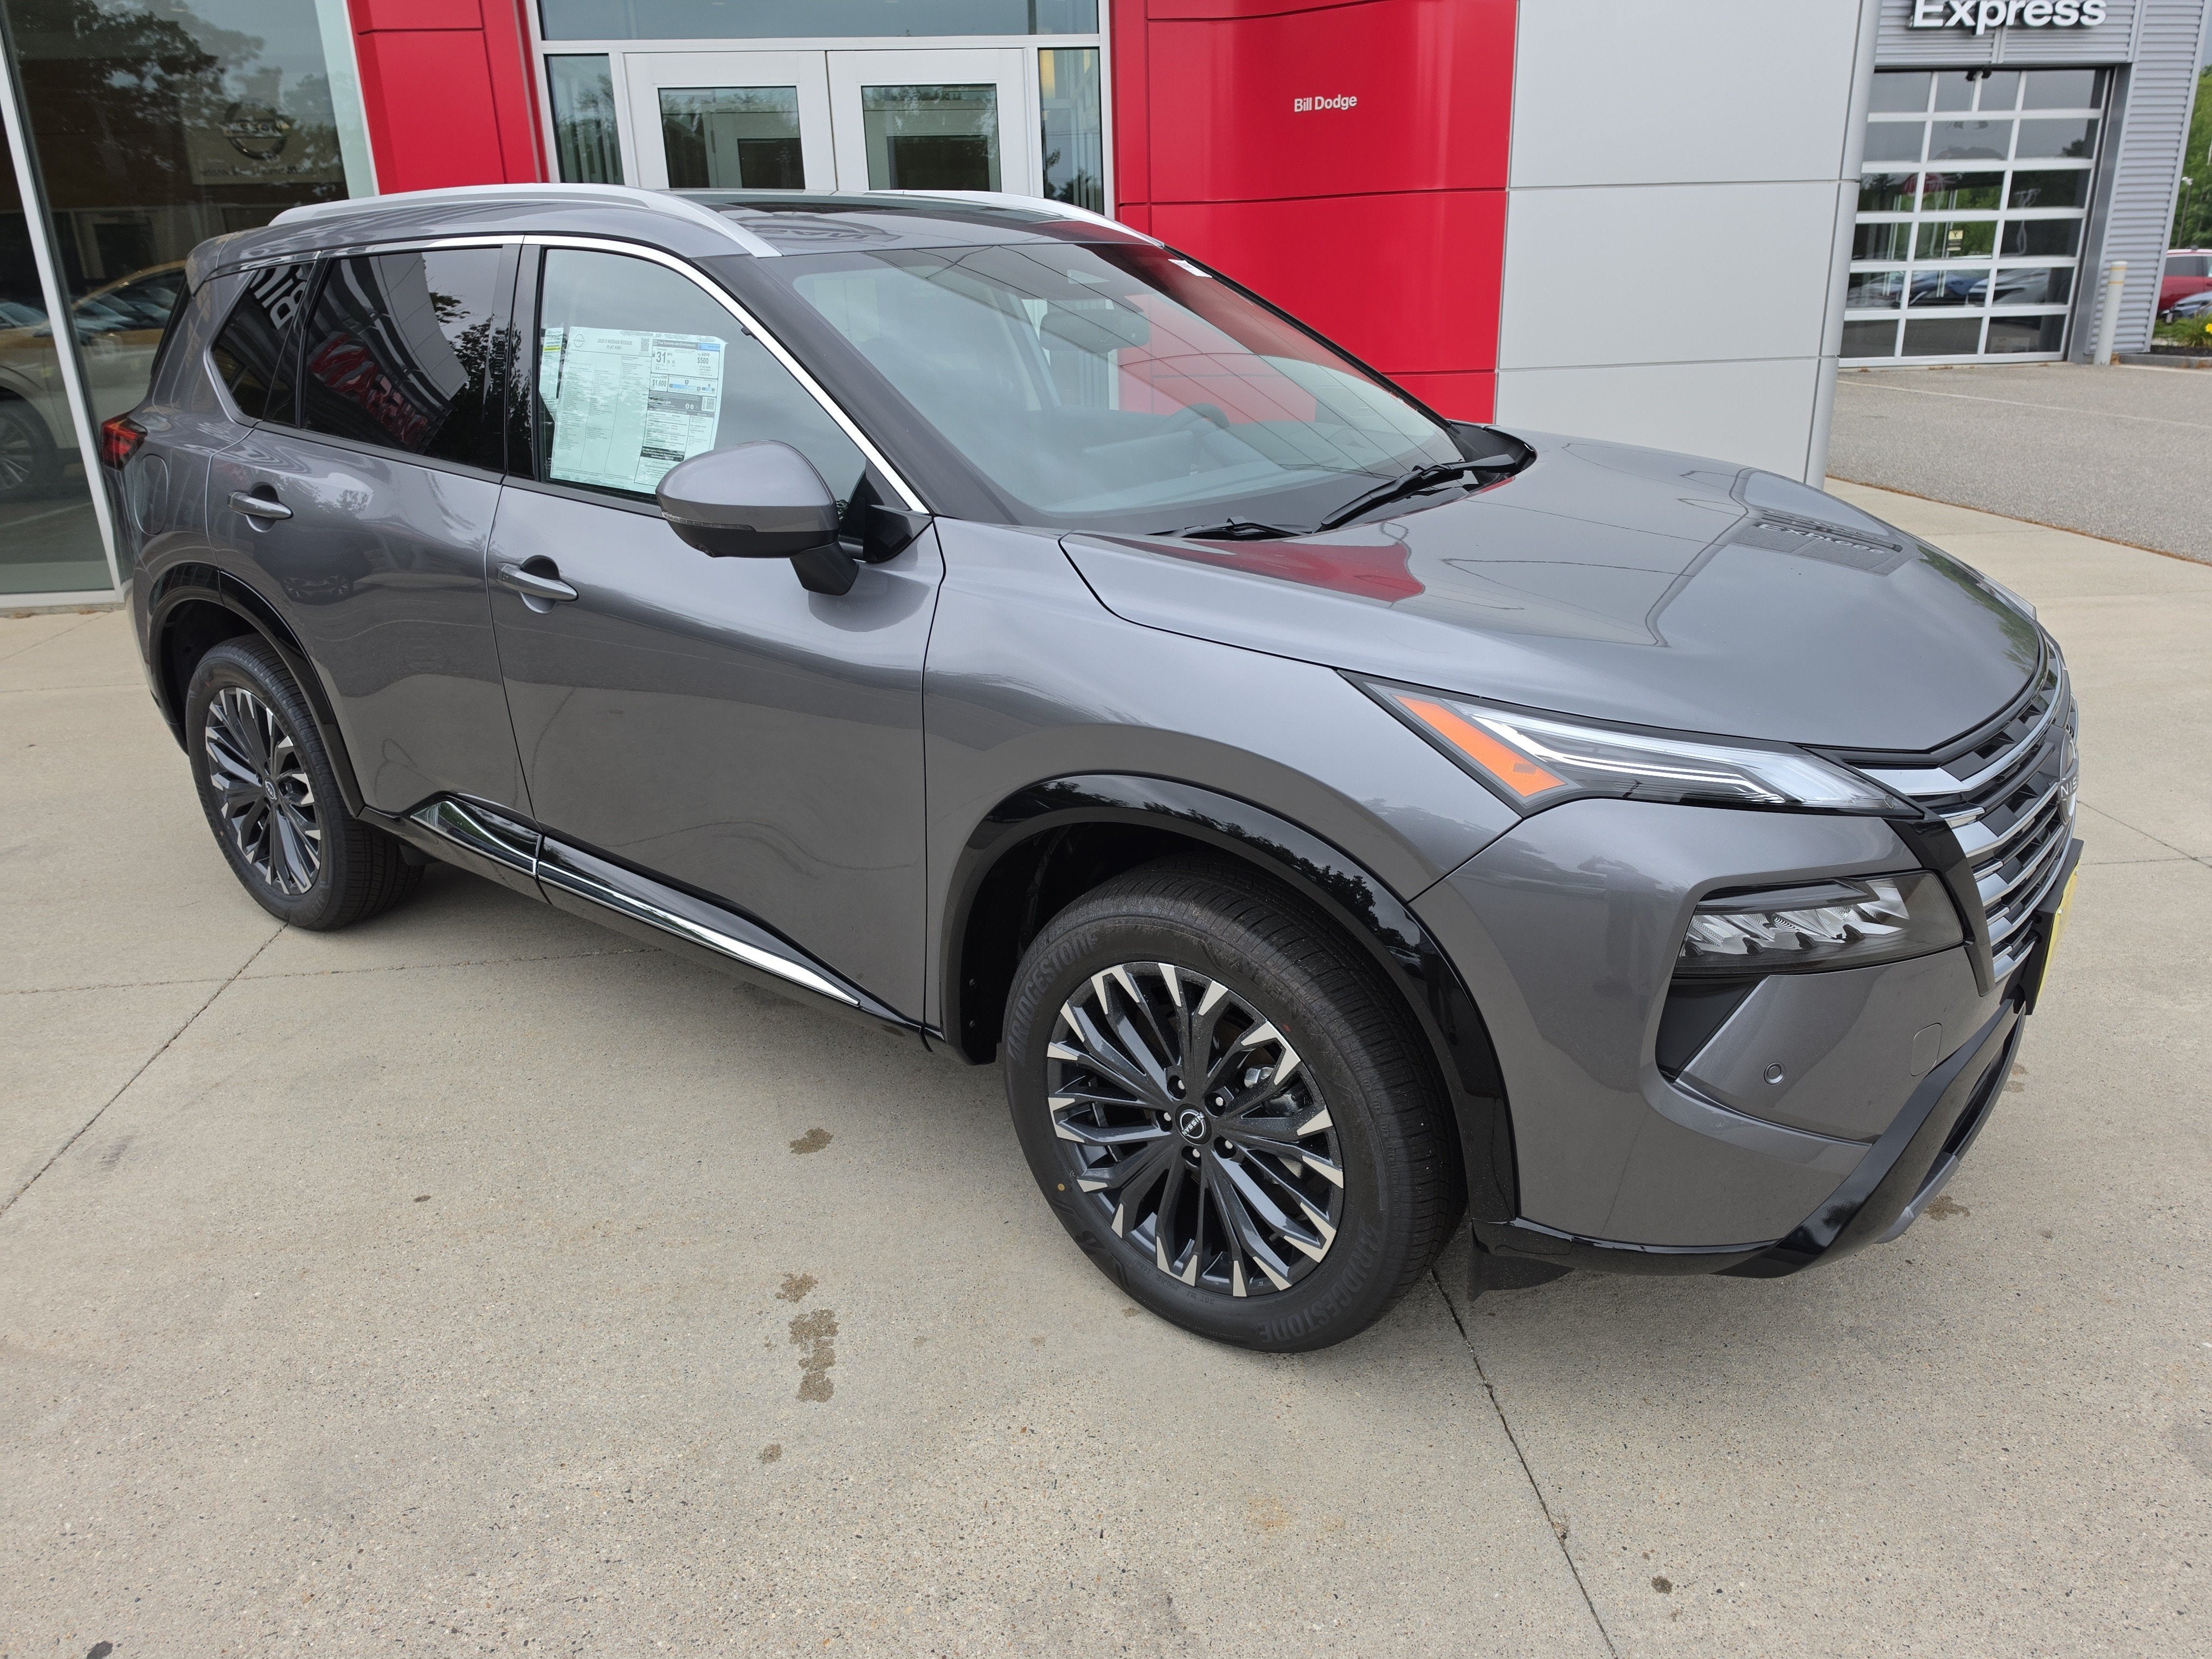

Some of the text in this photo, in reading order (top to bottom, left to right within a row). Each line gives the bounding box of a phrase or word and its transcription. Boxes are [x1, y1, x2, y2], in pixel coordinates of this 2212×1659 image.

[1912, 0, 2107, 35] Express
[1294, 94, 1357, 112] Bill Dodge
[656, 351, 666, 363] 31
[1007, 930, 1099, 1067] BRIDGESTONE
[1181, 1111, 1205, 1136] NISSAN
[1257, 1217, 1384, 1344] BRIDGESTONE
